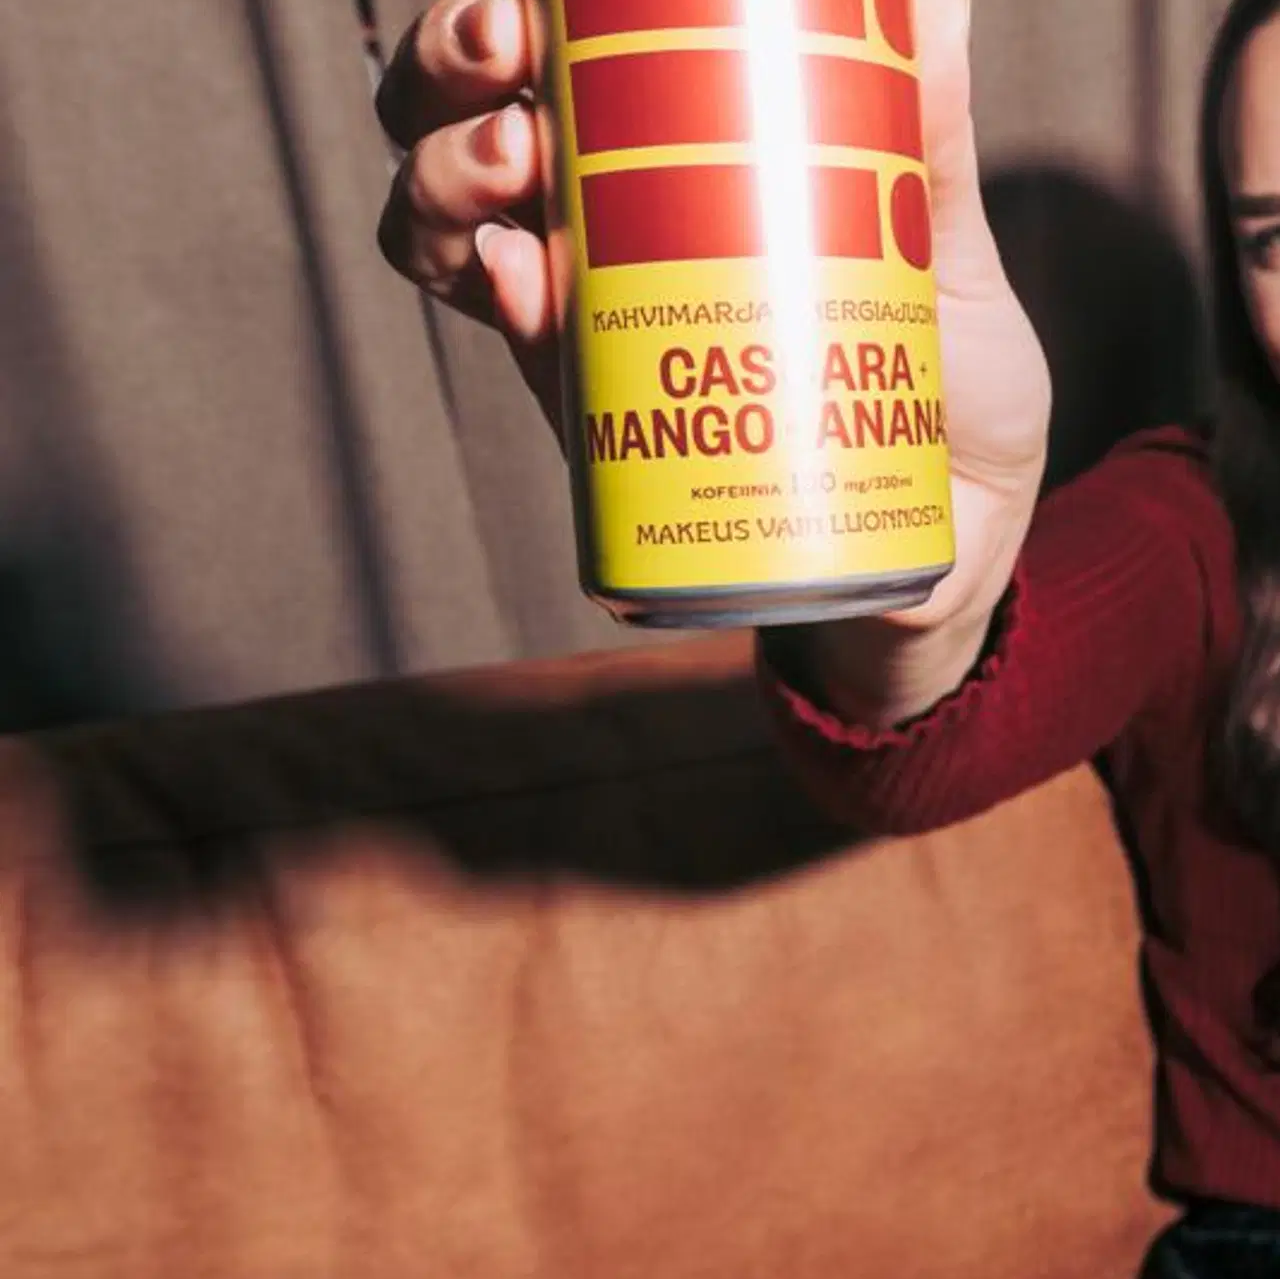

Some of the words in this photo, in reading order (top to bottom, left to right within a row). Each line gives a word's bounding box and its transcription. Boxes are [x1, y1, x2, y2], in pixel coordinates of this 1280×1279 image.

[659, 342, 915, 400] CASARA
[586, 403, 775, 464] MANGO
[691, 484, 782, 500] KOFEIINIA
[791, 470, 836, 495] 10
[636, 519, 750, 546] MAKEUS
